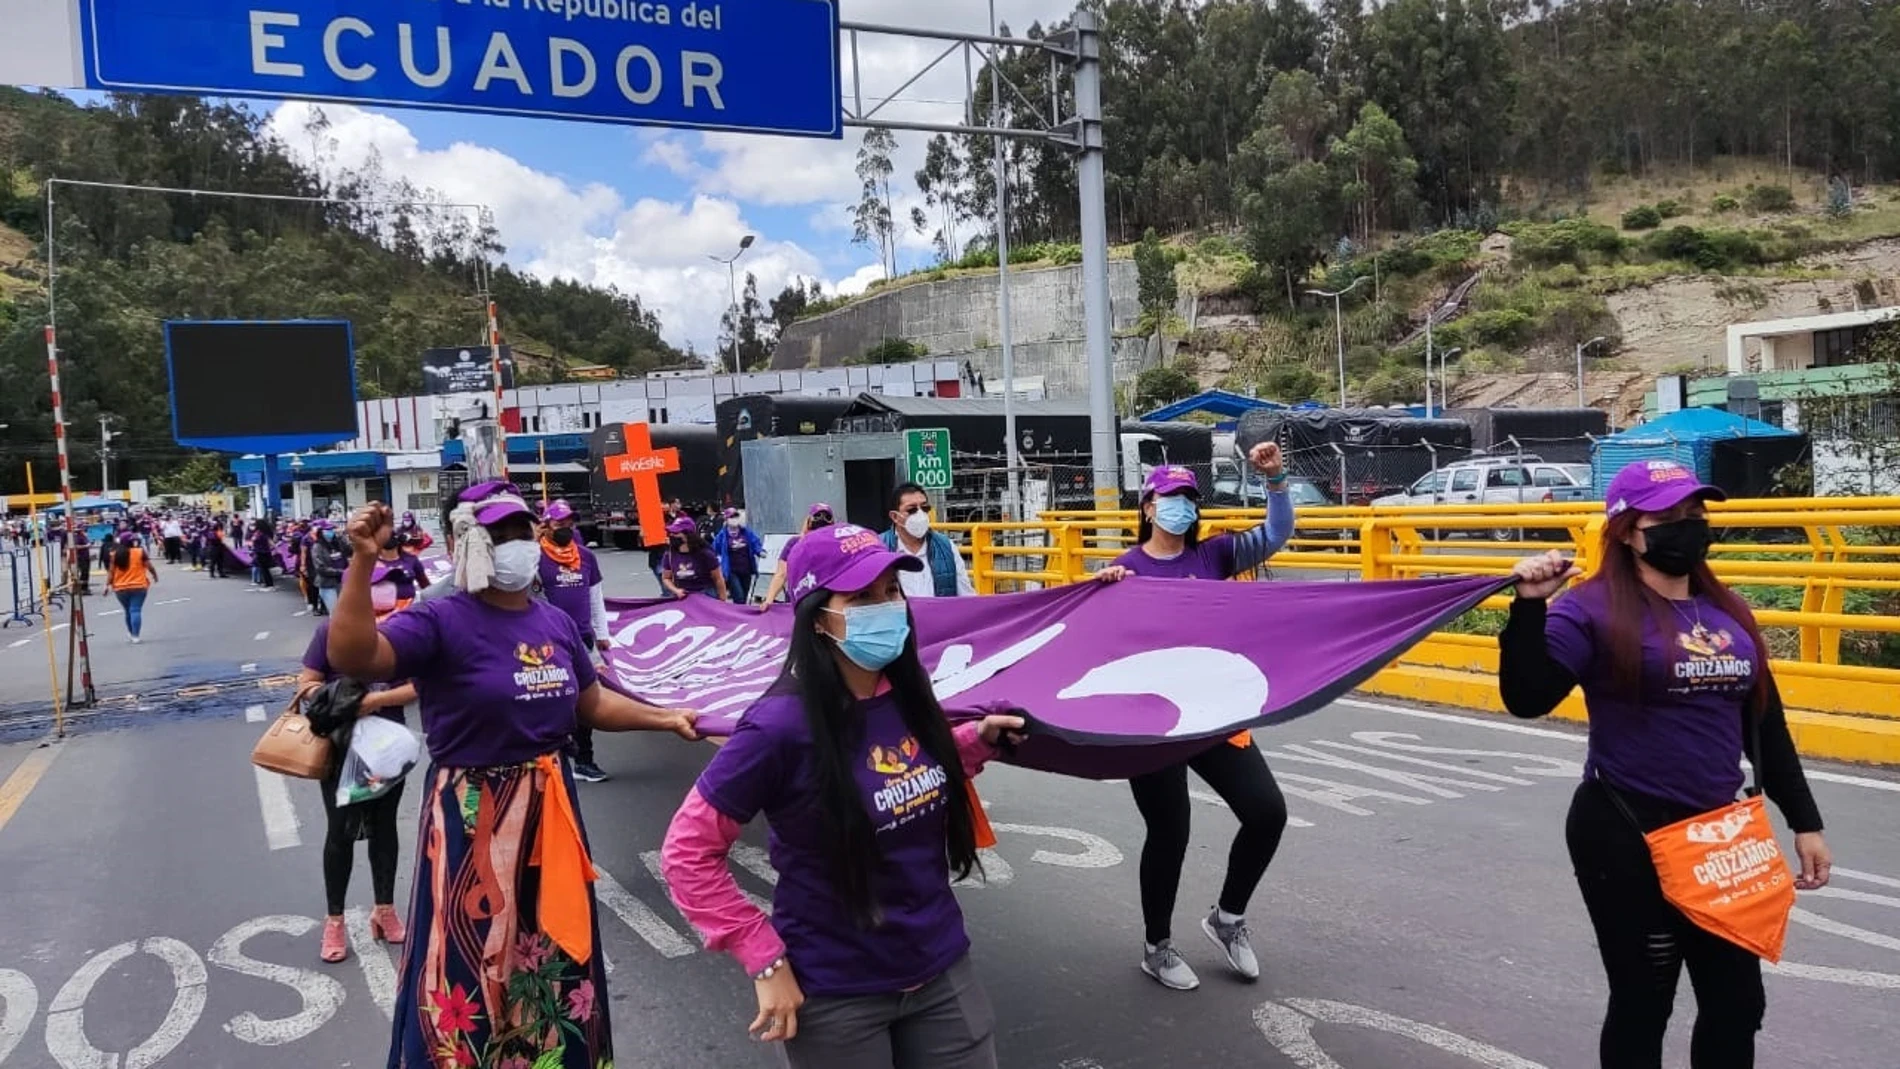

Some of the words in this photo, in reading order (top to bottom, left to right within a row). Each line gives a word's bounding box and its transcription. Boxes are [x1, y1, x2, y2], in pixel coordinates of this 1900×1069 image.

[680, 4, 721, 30] del
[249, 10, 726, 110] ECUADOR
[921, 431, 937, 440] SUR
[917, 455, 942, 469] km
[915, 469, 946, 486] 000
[513, 668, 570, 686] CRUZAMOS
[1674, 659, 1752, 678] CRUZAMOS
[873, 765, 947, 812] CRUZAMOS
[1693, 838, 1778, 886] CRUZAMOS
